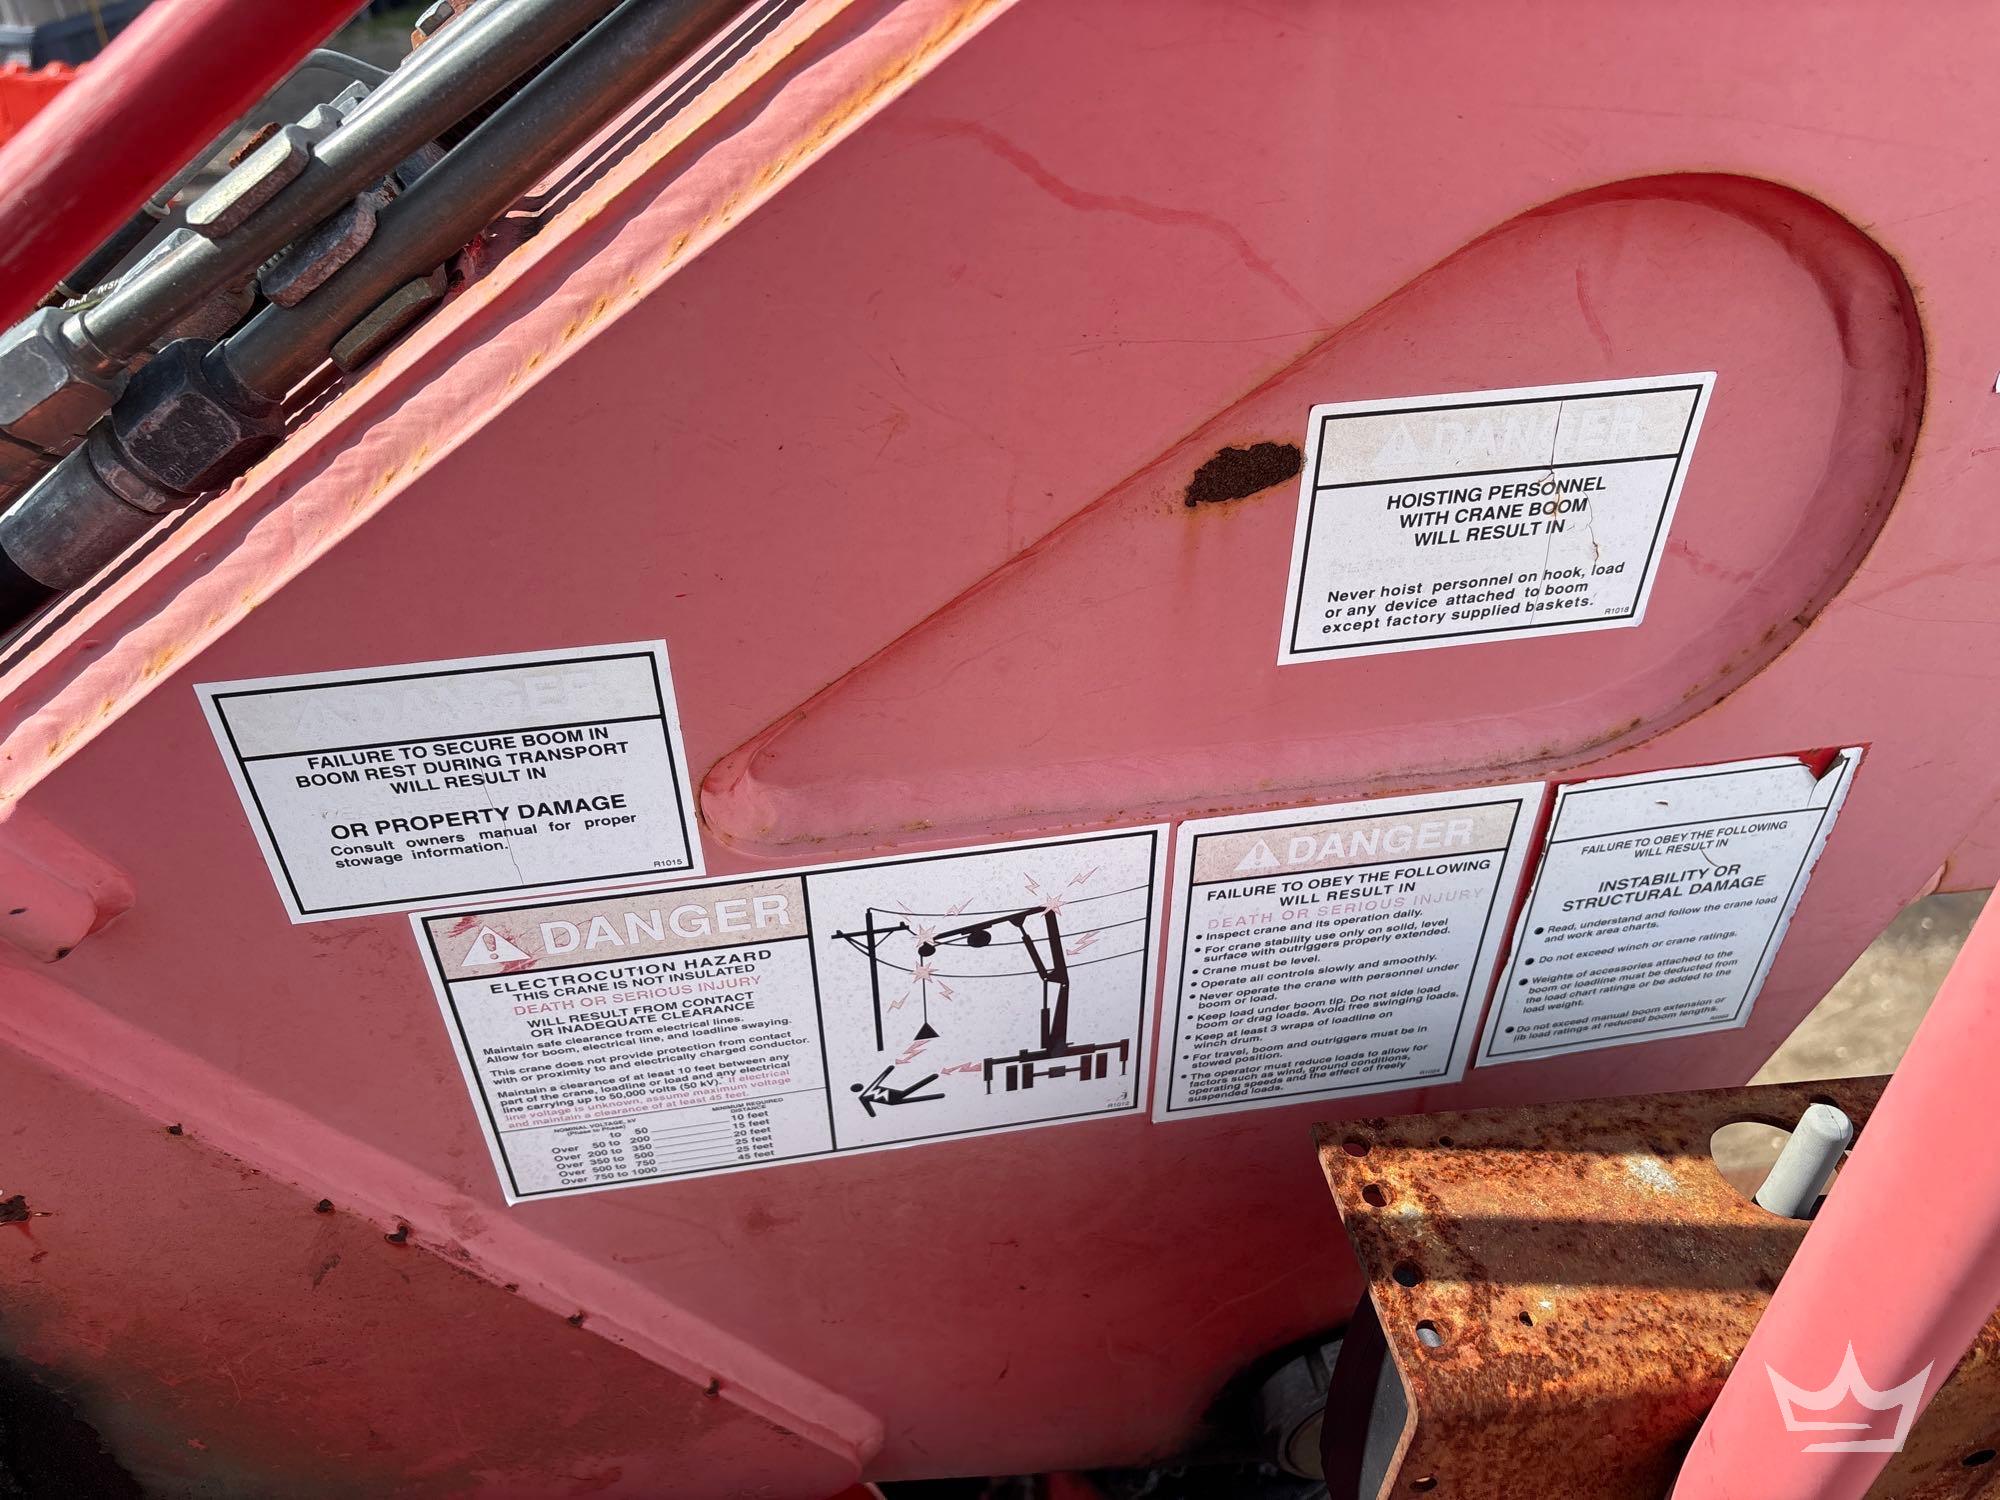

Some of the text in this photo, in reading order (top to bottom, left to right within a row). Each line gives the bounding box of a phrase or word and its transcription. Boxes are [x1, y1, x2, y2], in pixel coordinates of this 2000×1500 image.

[1386, 476, 1606, 510] HOISTING PERSONNEL
[1399, 496, 1589, 529] WITH CRANE BOOM
[1414, 518, 1566, 547] WILL RESULT IN
[1324, 582, 1588, 618] or any device attached to boom
[1327, 561, 1625, 603] Never hoist personnel on hook, load
[1322, 596, 1593, 634] except factory supplied baskets.
[1604, 605, 1630, 615] R1018
[295, 741, 629, 788] BOOM REST DURING TRANSPORT
[306, 726, 609, 770] FAILURE TO SECURE BOOM IN
[389, 766, 547, 794] WILL RESULT IN
[330, 822, 369, 840] OR
[374, 806, 509, 835] PROPERTY
[517, 793, 627, 819] DAMAGE
[330, 814, 637, 856] Consult owners manual for proper
[335, 838, 510, 868] stowage information.
[1286, 818, 1476, 865] DANGER
[1580, 820, 1788, 855] FAILURE TO OBEY THE FOLLOWING
[1634, 838, 1729, 858] WILL RESULT IN
[653, 858, 683, 868] R1015
[1207, 859, 1491, 901] FAILURE TO OBEY THE FOLLOWING
[1597, 863, 1741, 893] INSTABILITY OR
[1279, 881, 1416, 907] WILL RESULT IN
[1561, 874, 1766, 912] STRUCTURAL DAMAGE
[538, 894, 792, 955] DANGER
[1205, 908, 1423, 941] Inspect crane and its operation daily.
[1207, 912, 1273, 930] DEATH
[1281, 908, 1309, 921] OR
[1317, 896, 1405, 917] SERIOUS
[1547, 895, 1778, 933] Read, understand and follow the crane load
[1203, 926, 1450, 963] surface with outriggers properly extended.
[1204, 917, 1449, 954] For crane stability use only on solid, level
[1538, 930, 1737, 964] Do not exceed winch or crane ratings.
[1543, 921, 1659, 943] and work area charts.
[489, 949, 771, 994] ELECTROCUTION HAZARD
[512, 963, 755, 1002] THIS CRANE IS NOT INSULATED
[1202, 954, 1320, 976] Crane must be level.
[513, 974, 761, 1016] DEATH OR SERIOUS INJURY
[526, 990, 754, 1028] WILL RESULT FROM CONTACT
[482, 1016, 744, 1055] Maintain safe clearance from electrical lines.
[530, 1000, 755, 1038] OR INADEQUATE CLEARANCE
[486, 1018, 792, 1064] Allow for boom, electrical line, and loadline swaying.
